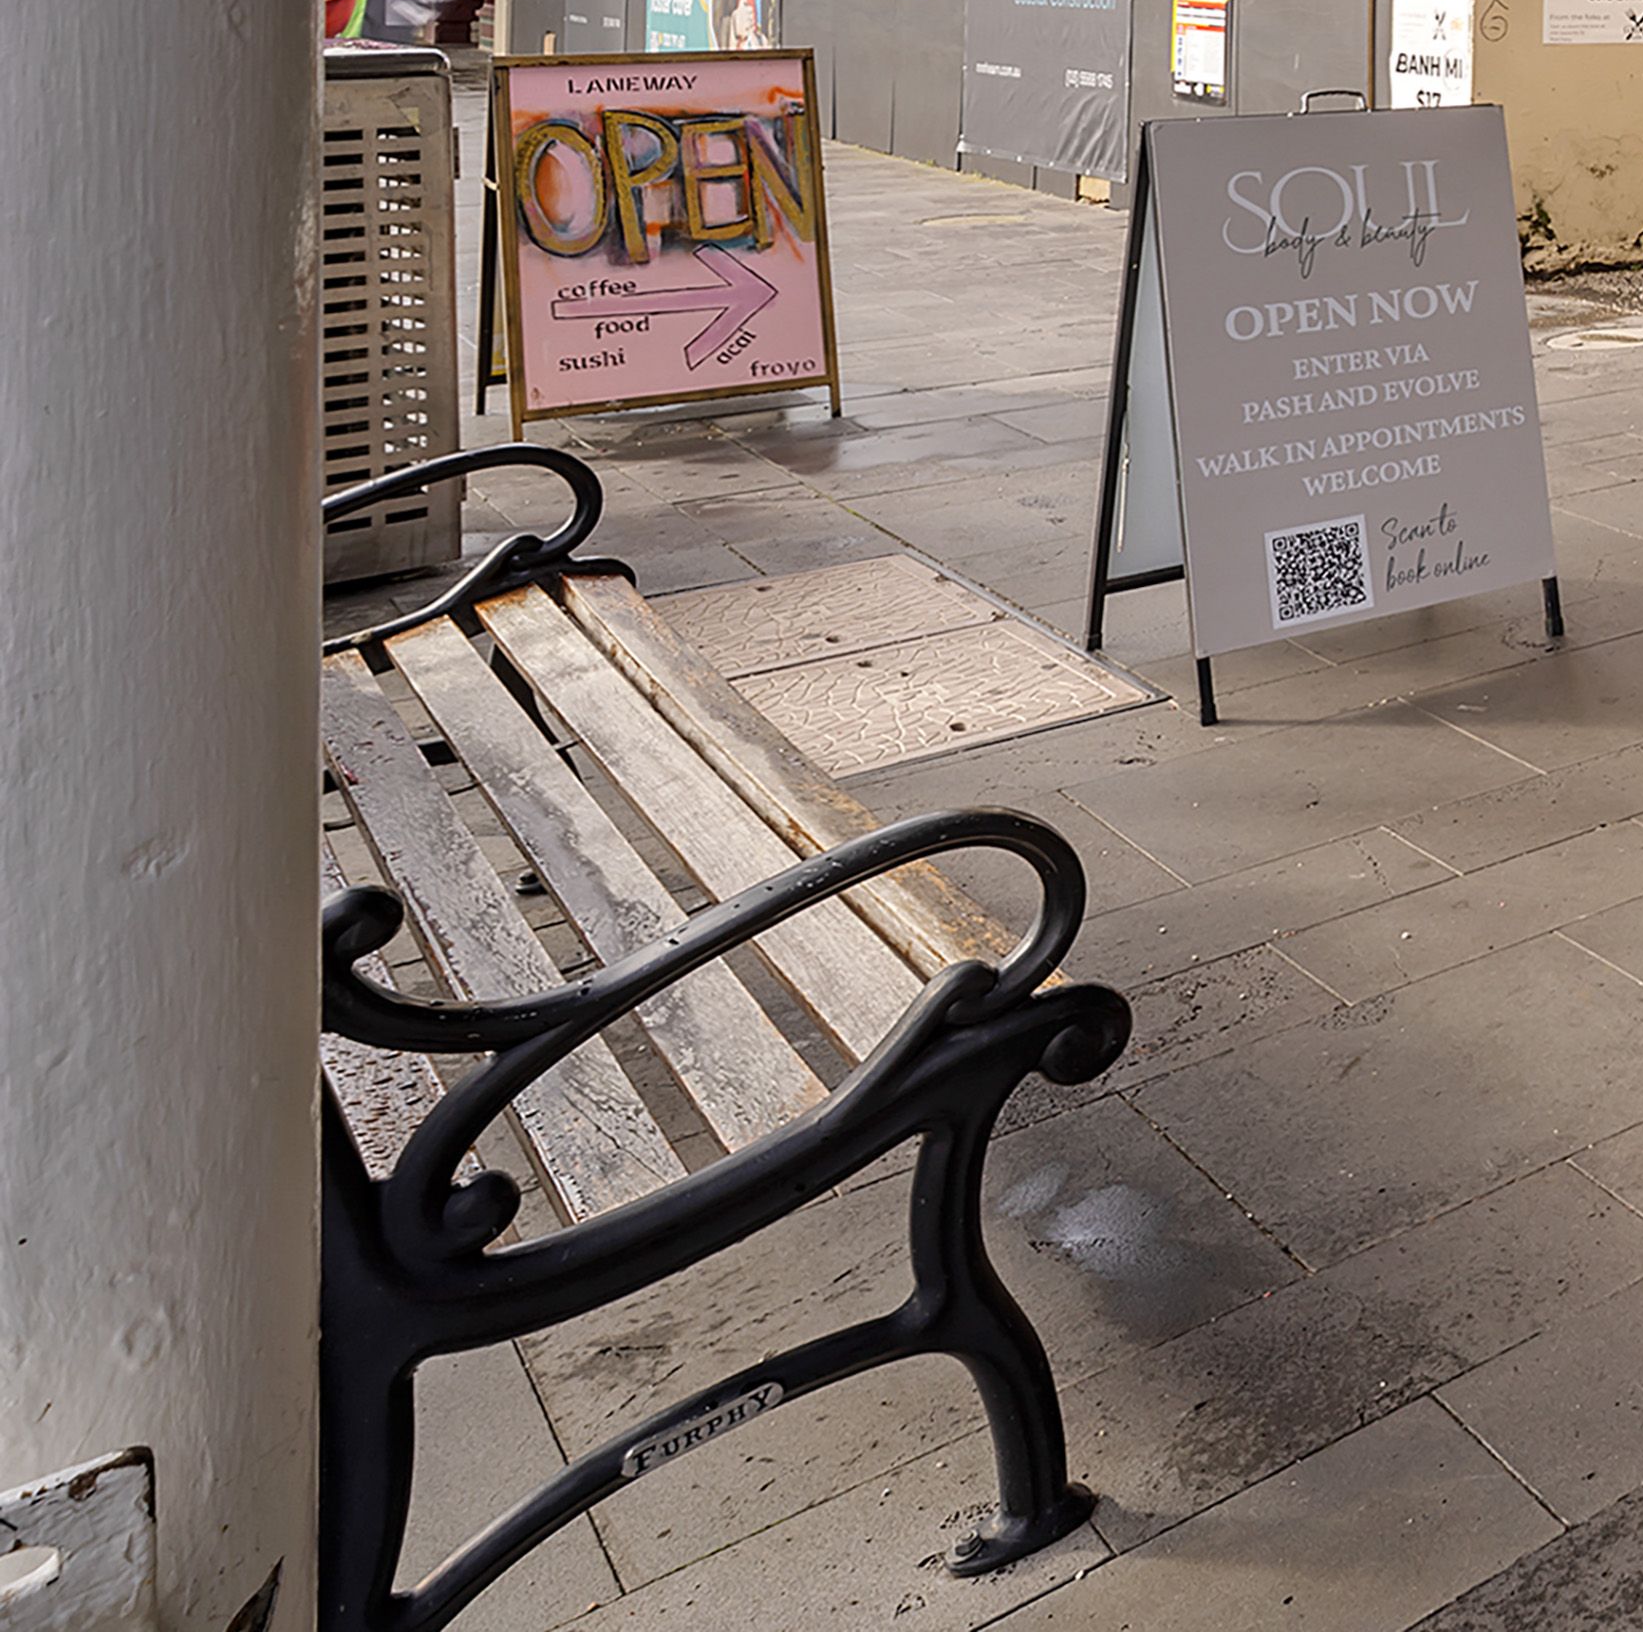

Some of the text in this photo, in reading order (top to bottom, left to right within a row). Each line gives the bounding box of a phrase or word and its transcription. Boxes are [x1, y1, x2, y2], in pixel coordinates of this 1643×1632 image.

[568, 75, 697, 95] LANEWAY
[1395, 53, 1463, 79] BANH MI
[514, 109, 815, 264] OPEN
[1222, 159, 1471, 254] SOUL
[1264, 208, 1442, 279] body & beauty
[557, 279, 637, 301] coffee
[1224, 280, 1479, 341] OPEN NOW
[595, 316, 650, 339] food
[716, 330, 757, 366] acai
[559, 348, 625, 372] sushi
[750, 358, 816, 377] froyo
[1292, 343, 1430, 379] ENTER VIA
[1242, 369, 1480, 423] PASH AND EVOLVE
[1196, 406, 1525, 478] WALK IN APPOINTMENTS
[1302, 454, 1442, 497] WELCOME
[1380, 502, 1457, 550] Scan to
[1386, 540, 1490, 591] book online
[632, 1385, 775, 1475] FURPHY
